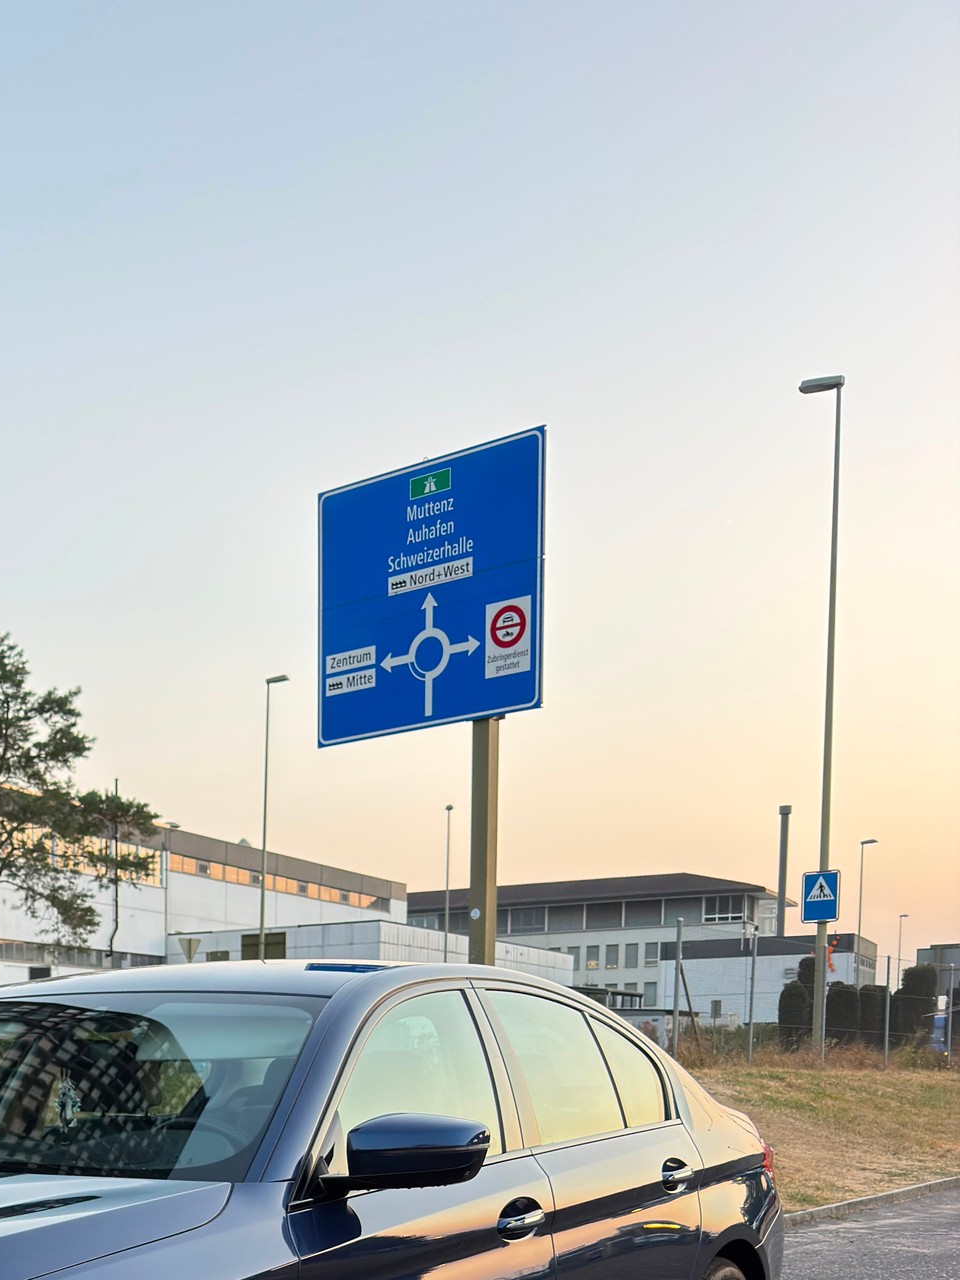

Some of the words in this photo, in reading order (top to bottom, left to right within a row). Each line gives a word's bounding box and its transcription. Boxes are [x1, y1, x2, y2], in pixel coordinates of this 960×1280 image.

[406, 498, 454, 522] Muttenz
[406, 519, 455, 545] Auhafen
[388, 536, 474, 573] Schweizerhalle
[409, 561, 470, 587] Nord+West
[330, 652, 372, 669] Zentrum
[487, 648, 529, 664] Zubringerdienst
[495, 660, 520, 674] gestattet
[346, 674, 373, 688] Mitte
